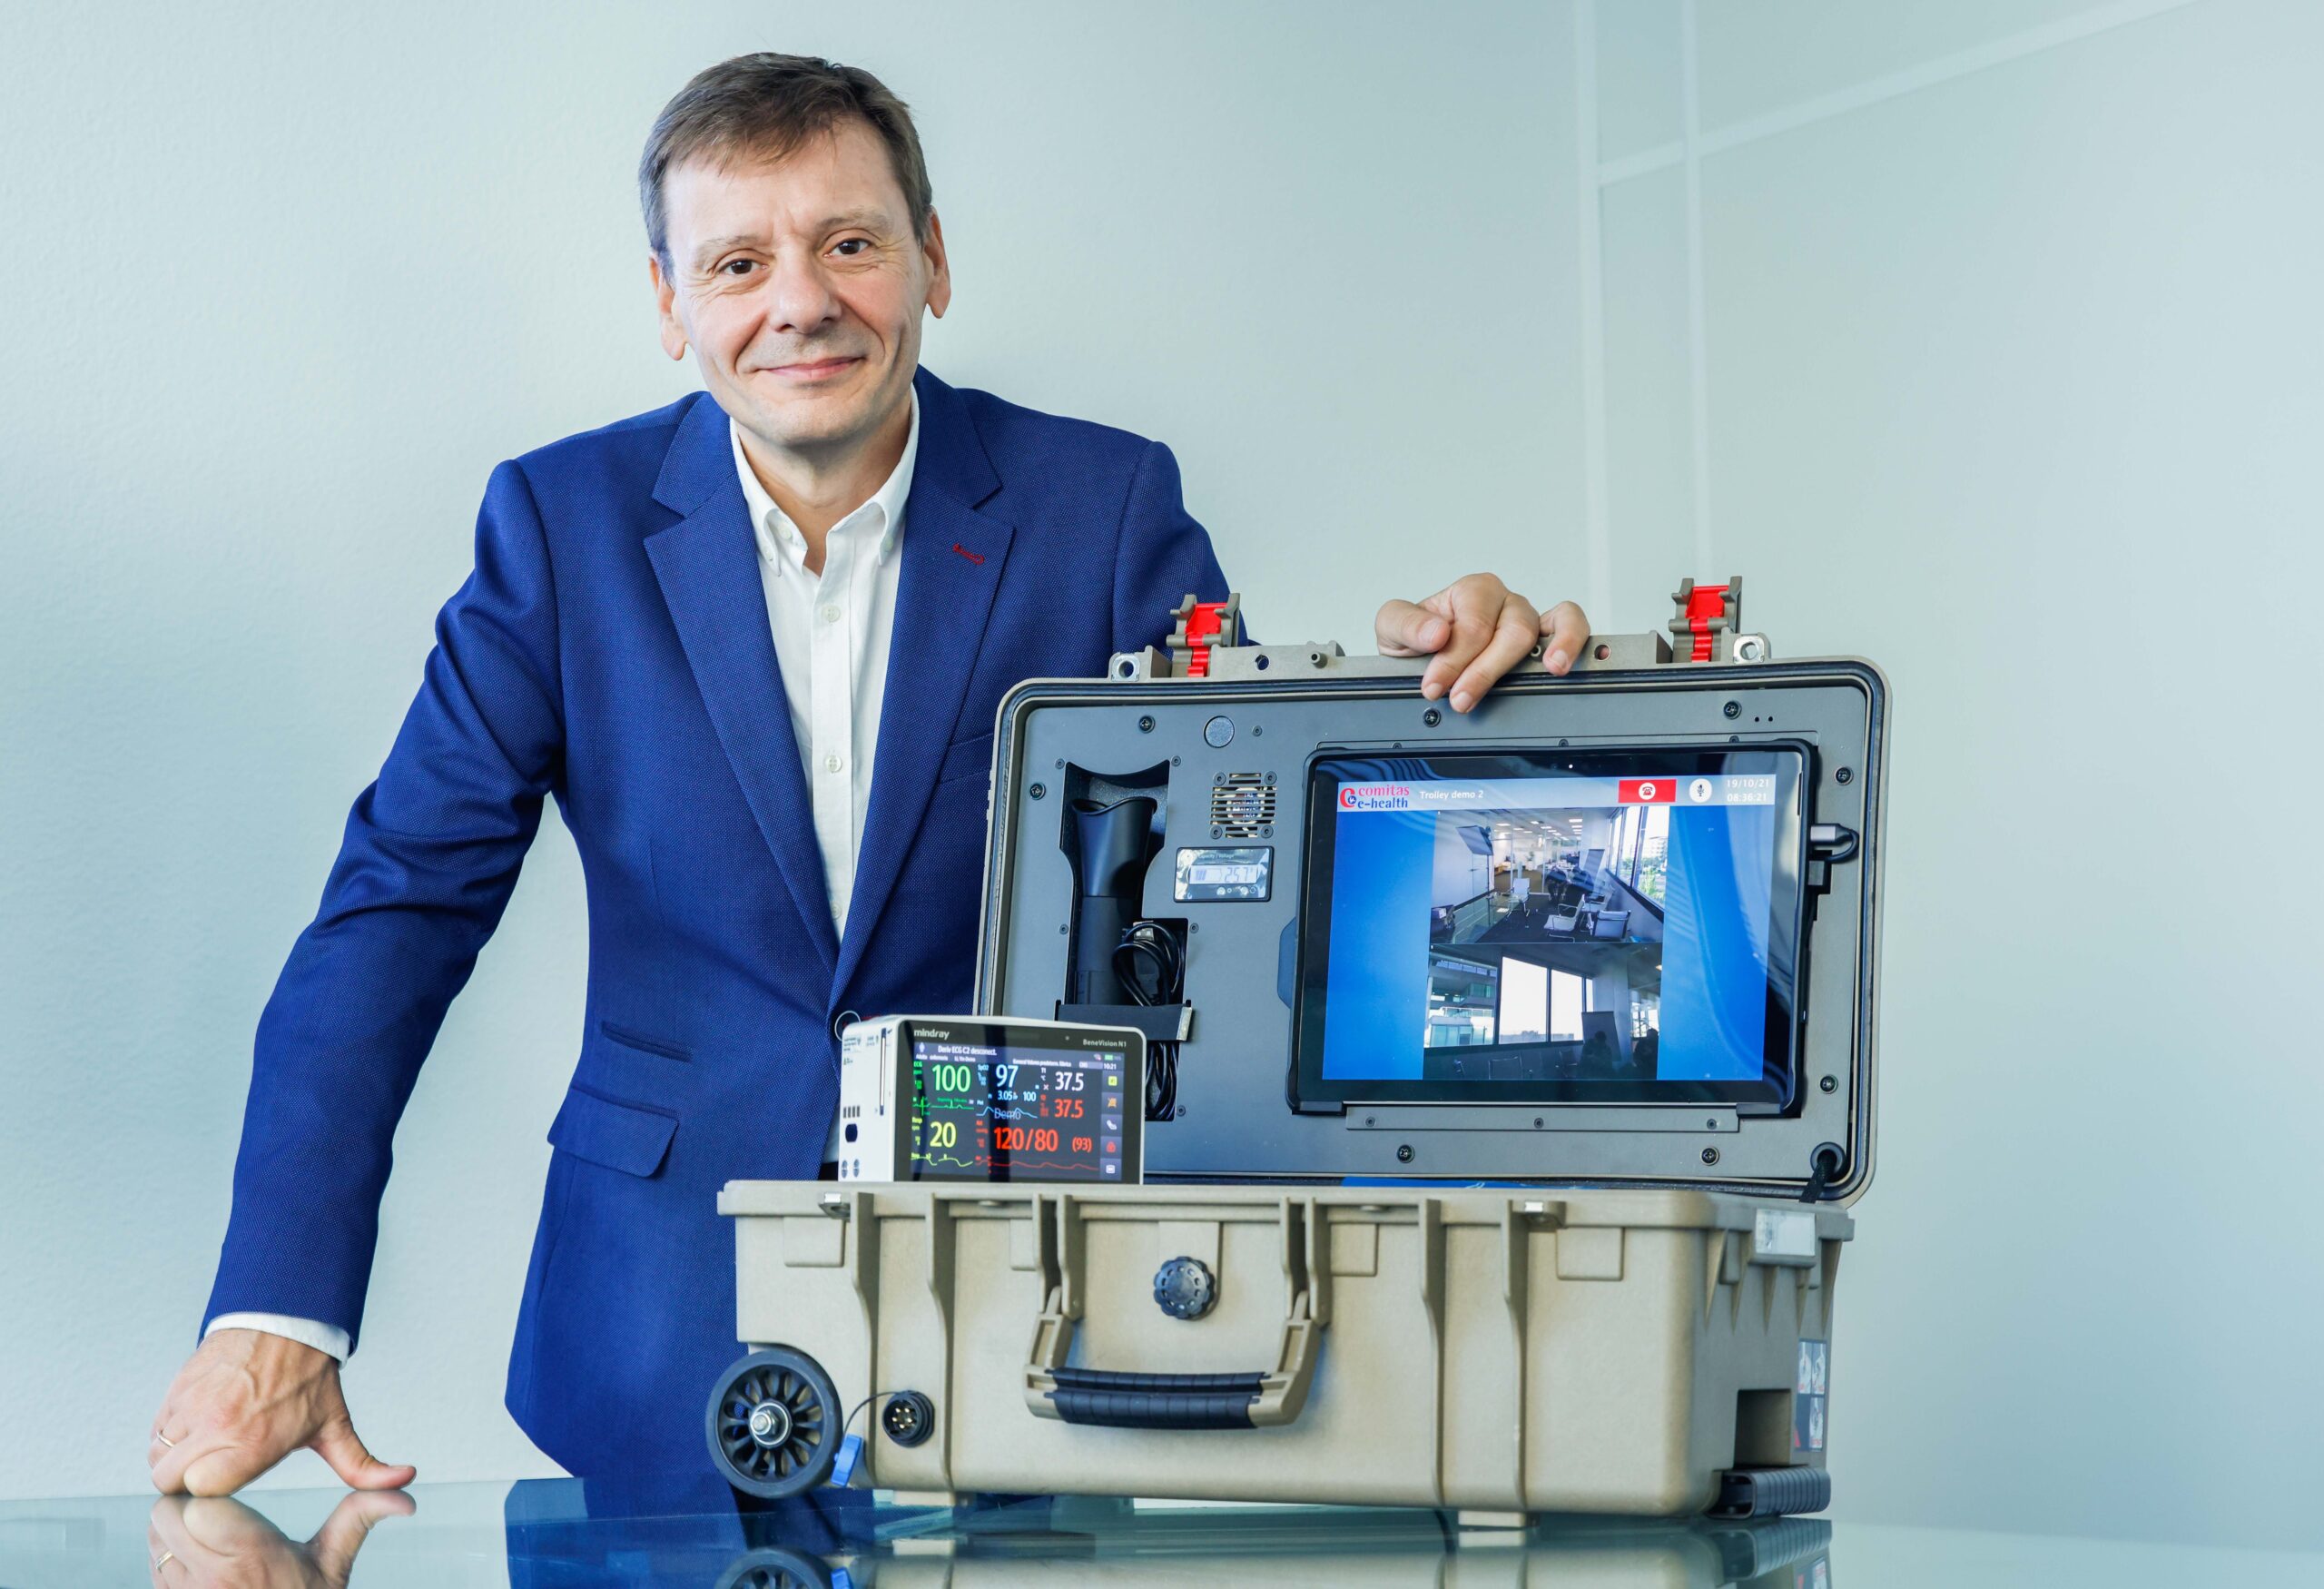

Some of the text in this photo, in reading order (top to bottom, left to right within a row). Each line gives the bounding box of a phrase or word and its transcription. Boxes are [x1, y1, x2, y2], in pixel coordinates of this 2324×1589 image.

[1728, 779, 1768, 788] 19/10/21
[1357, 784, 1410, 797] comitas
[1420, 790, 1484, 801] Trolley demo 2
[1357, 797, 1408, 809] e-health
[913, 1028, 950, 1041] mindray
[1082, 1039, 1118, 1047] BeneVision
[962, 1046, 970, 1054] C2
[932, 1063, 971, 1093] 100
[995, 1063, 1019, 1088] 97
[1054, 1071, 1085, 1091] 37.5
[997, 1090, 1013, 1101] 3.05
[1022, 1091, 1037, 1102] 100
[993, 1107, 1022, 1120] Demo
[1054, 1098, 1084, 1119] 37.5
[929, 1120, 957, 1149] 20
[993, 1126, 1059, 1152] 120/80
[1071, 1136, 1093, 1153] (93)
